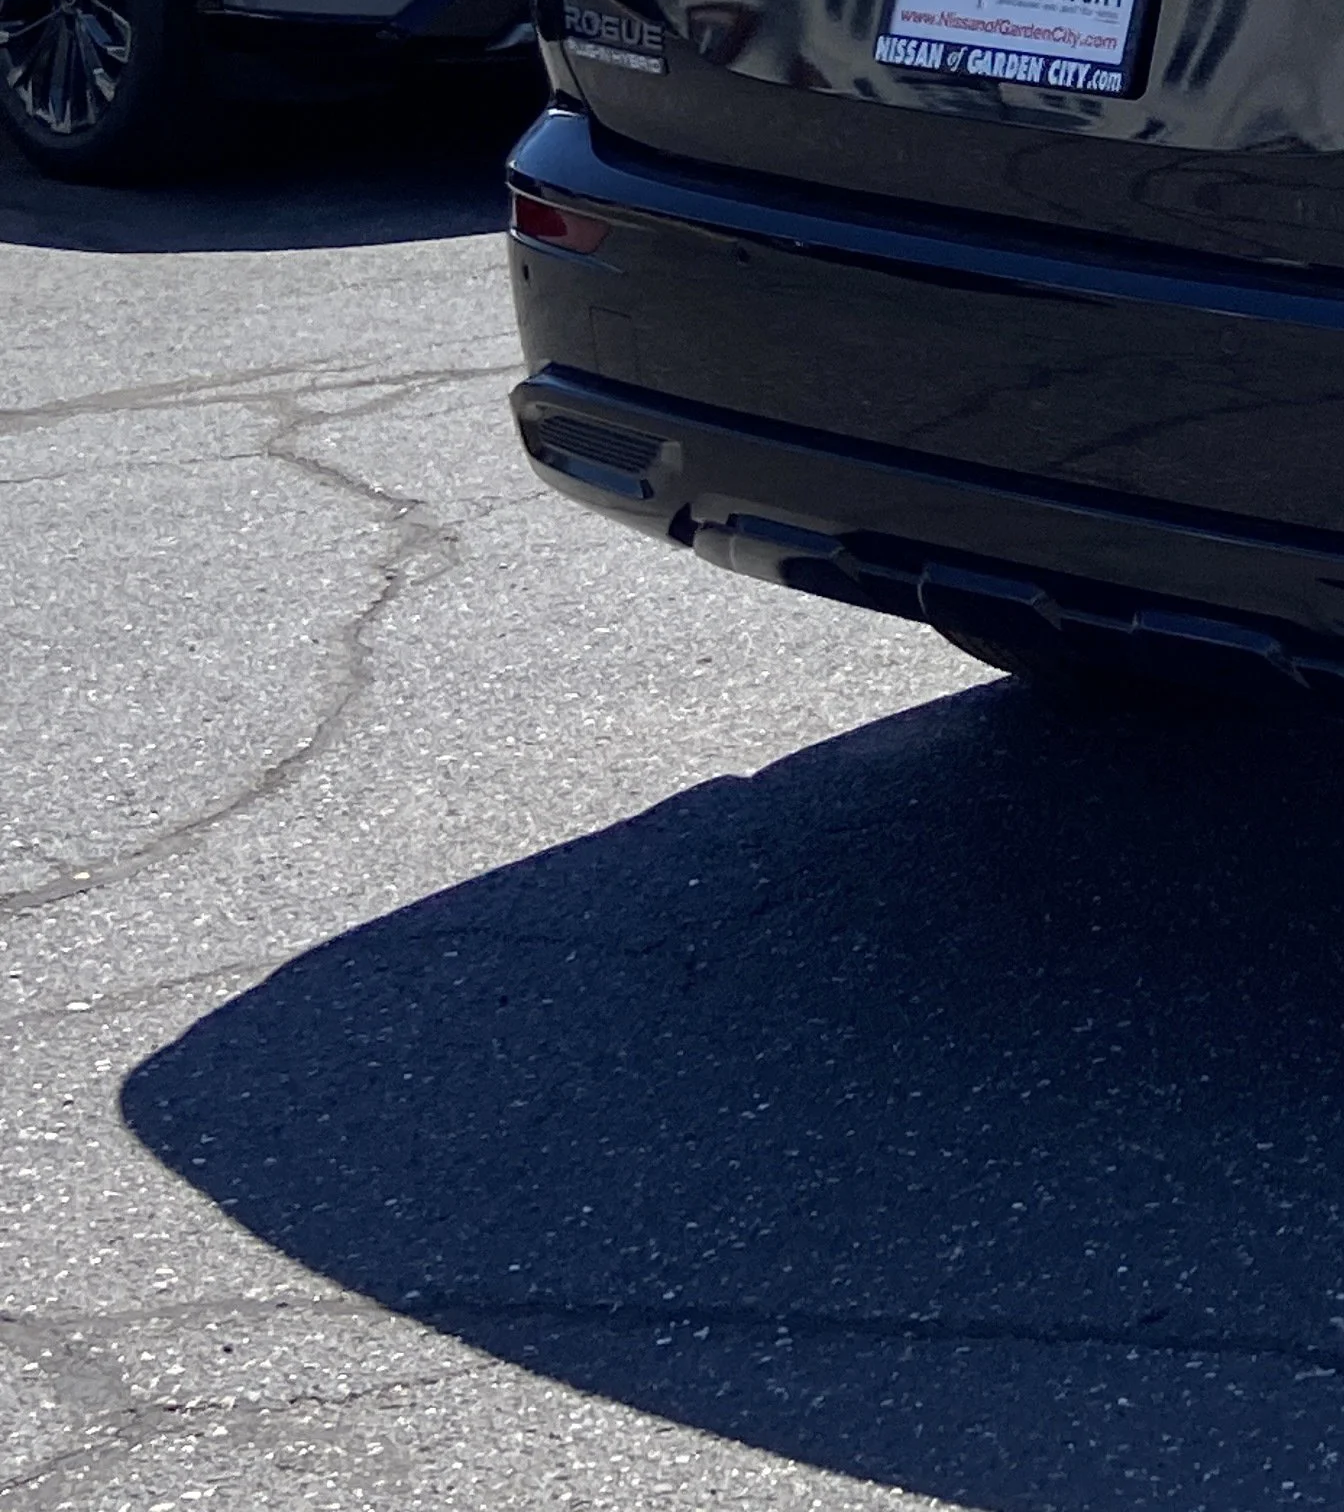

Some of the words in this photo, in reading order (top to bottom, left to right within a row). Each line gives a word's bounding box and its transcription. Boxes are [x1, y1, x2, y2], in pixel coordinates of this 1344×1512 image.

[564, 4, 664, 51] ROGUE
[875, 35, 944, 69] NISSAN
[947, 45, 968, 72] of
[967, 49, 1044, 83] GARDEN
